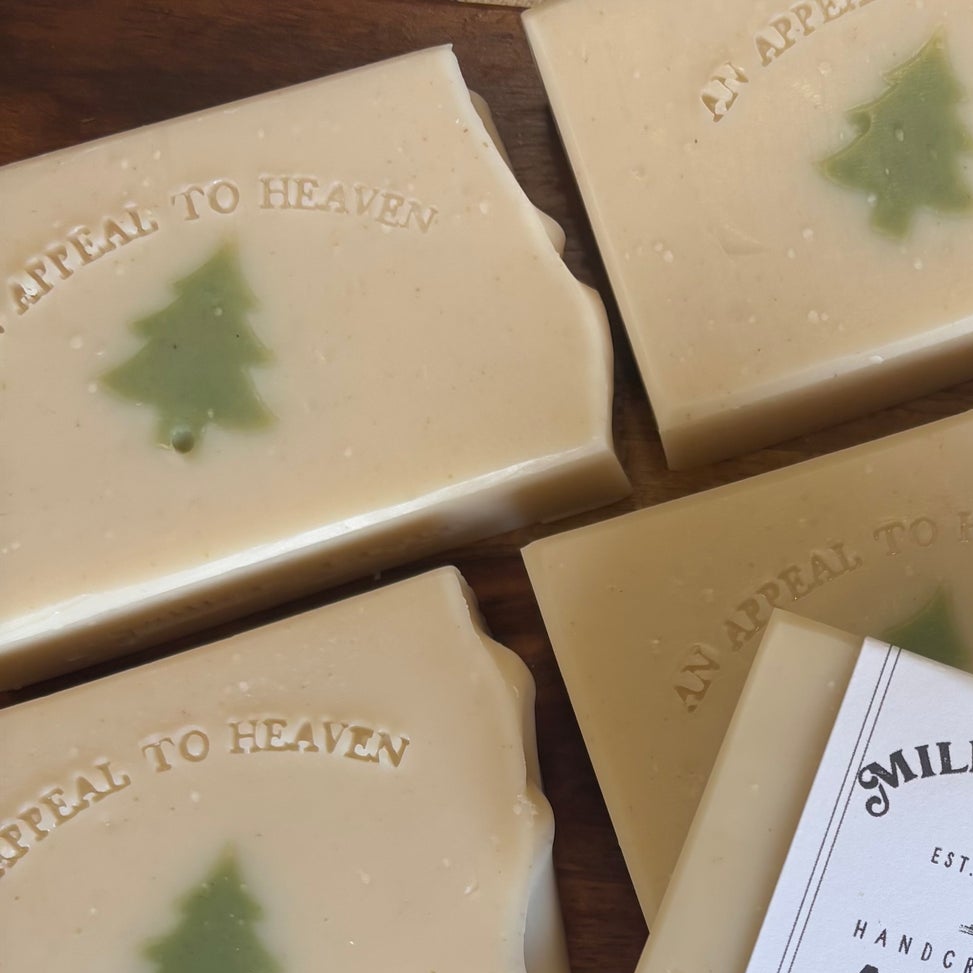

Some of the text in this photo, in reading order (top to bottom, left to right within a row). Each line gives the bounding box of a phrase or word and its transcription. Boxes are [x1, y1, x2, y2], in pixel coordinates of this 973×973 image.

[701, 62, 749, 123] AN
[170, 178, 241, 222] TO
[259, 175, 438, 234] HEAVEN
[674, 642, 720, 712] AN
[723, 542, 863, 652] APPEAL
[873, 517, 939, 555] TO
[142, 729, 210, 773] TO
[228, 718, 411, 769] HEAVEN
[931, 846, 973, 877] EST.
